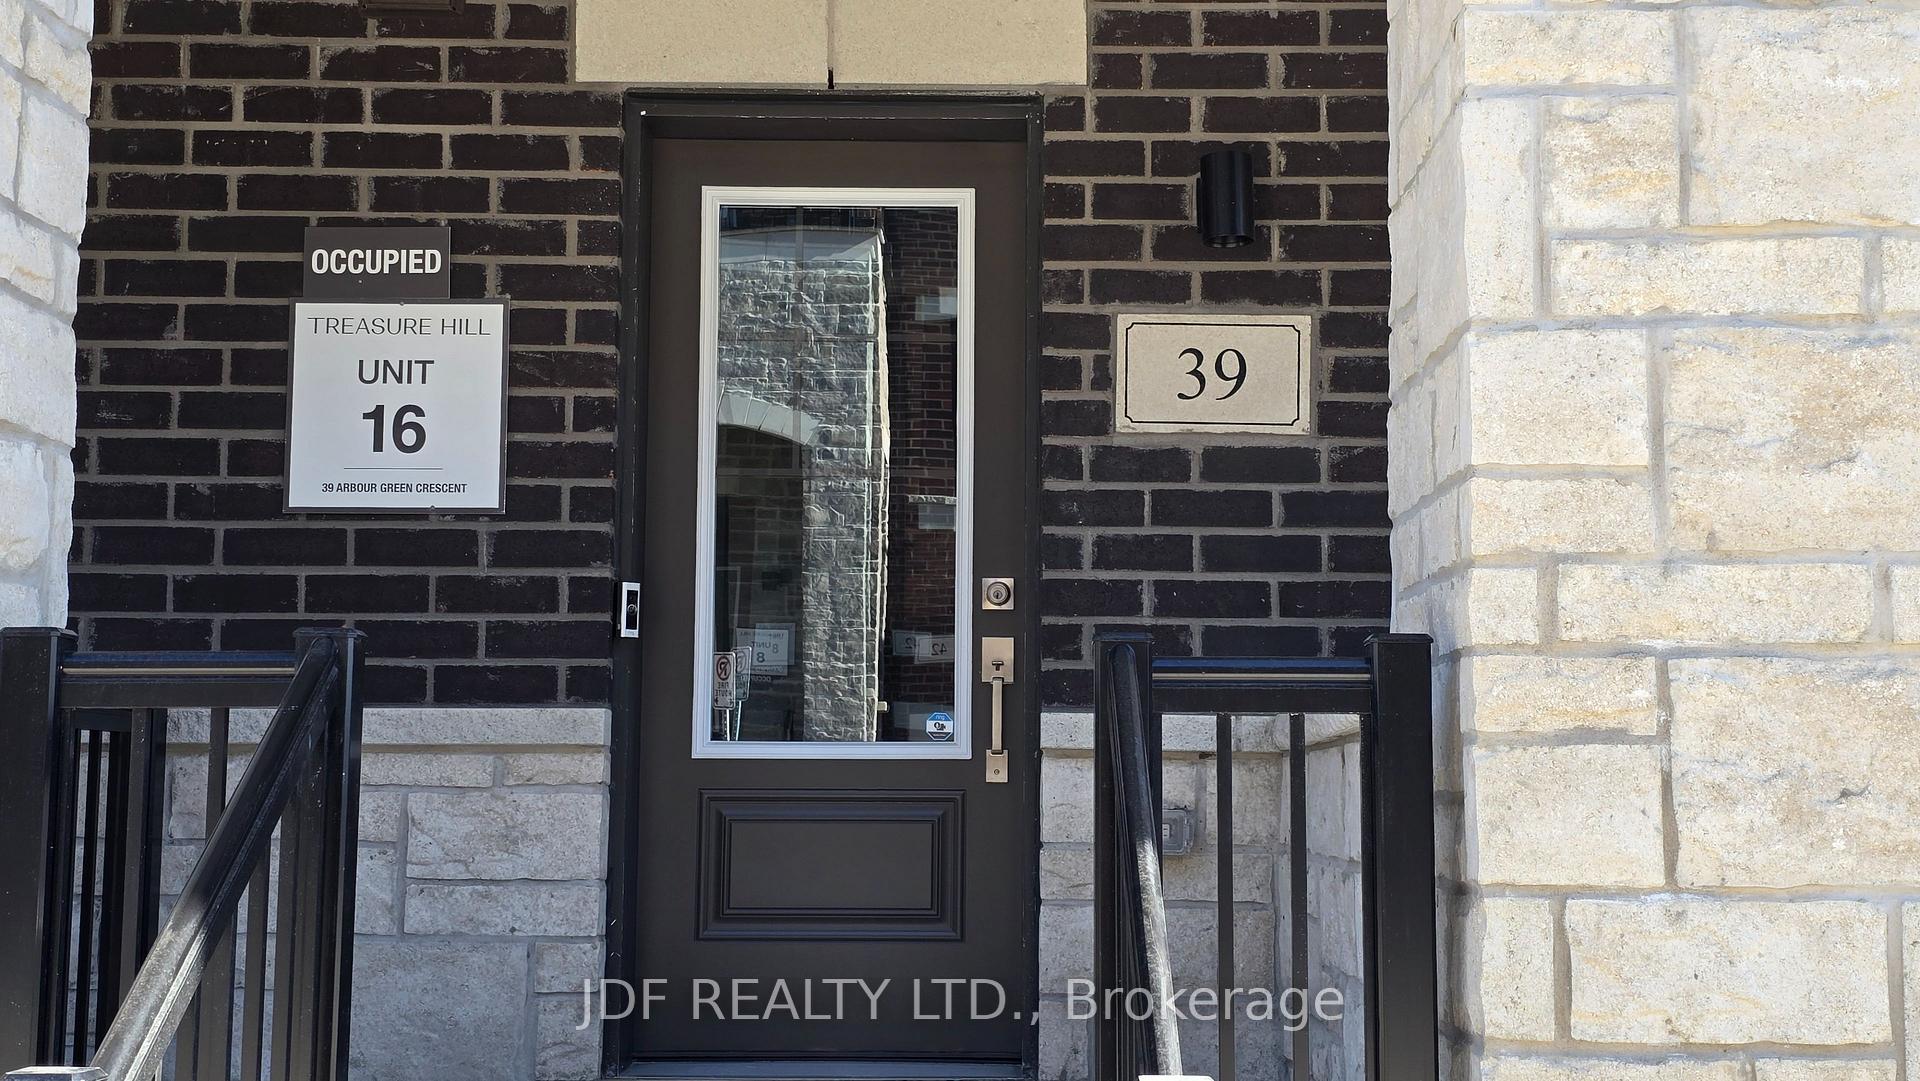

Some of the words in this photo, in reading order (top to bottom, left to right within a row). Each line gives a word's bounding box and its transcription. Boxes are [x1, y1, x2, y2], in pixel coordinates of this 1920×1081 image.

[311, 249, 442, 274] OCCUPIED
[307, 317, 432, 335] TREASURE
[441, 318, 491, 336] HILL
[358, 360, 434, 385] UNIT
[1177, 347, 1247, 401] 39
[362, 404, 427, 454] 16
[321, 483, 334, 493] 39
[336, 483, 377, 493] ARBOUR
[380, 483, 413, 493] GREEN
[416, 483, 468, 493] CRESCENT
